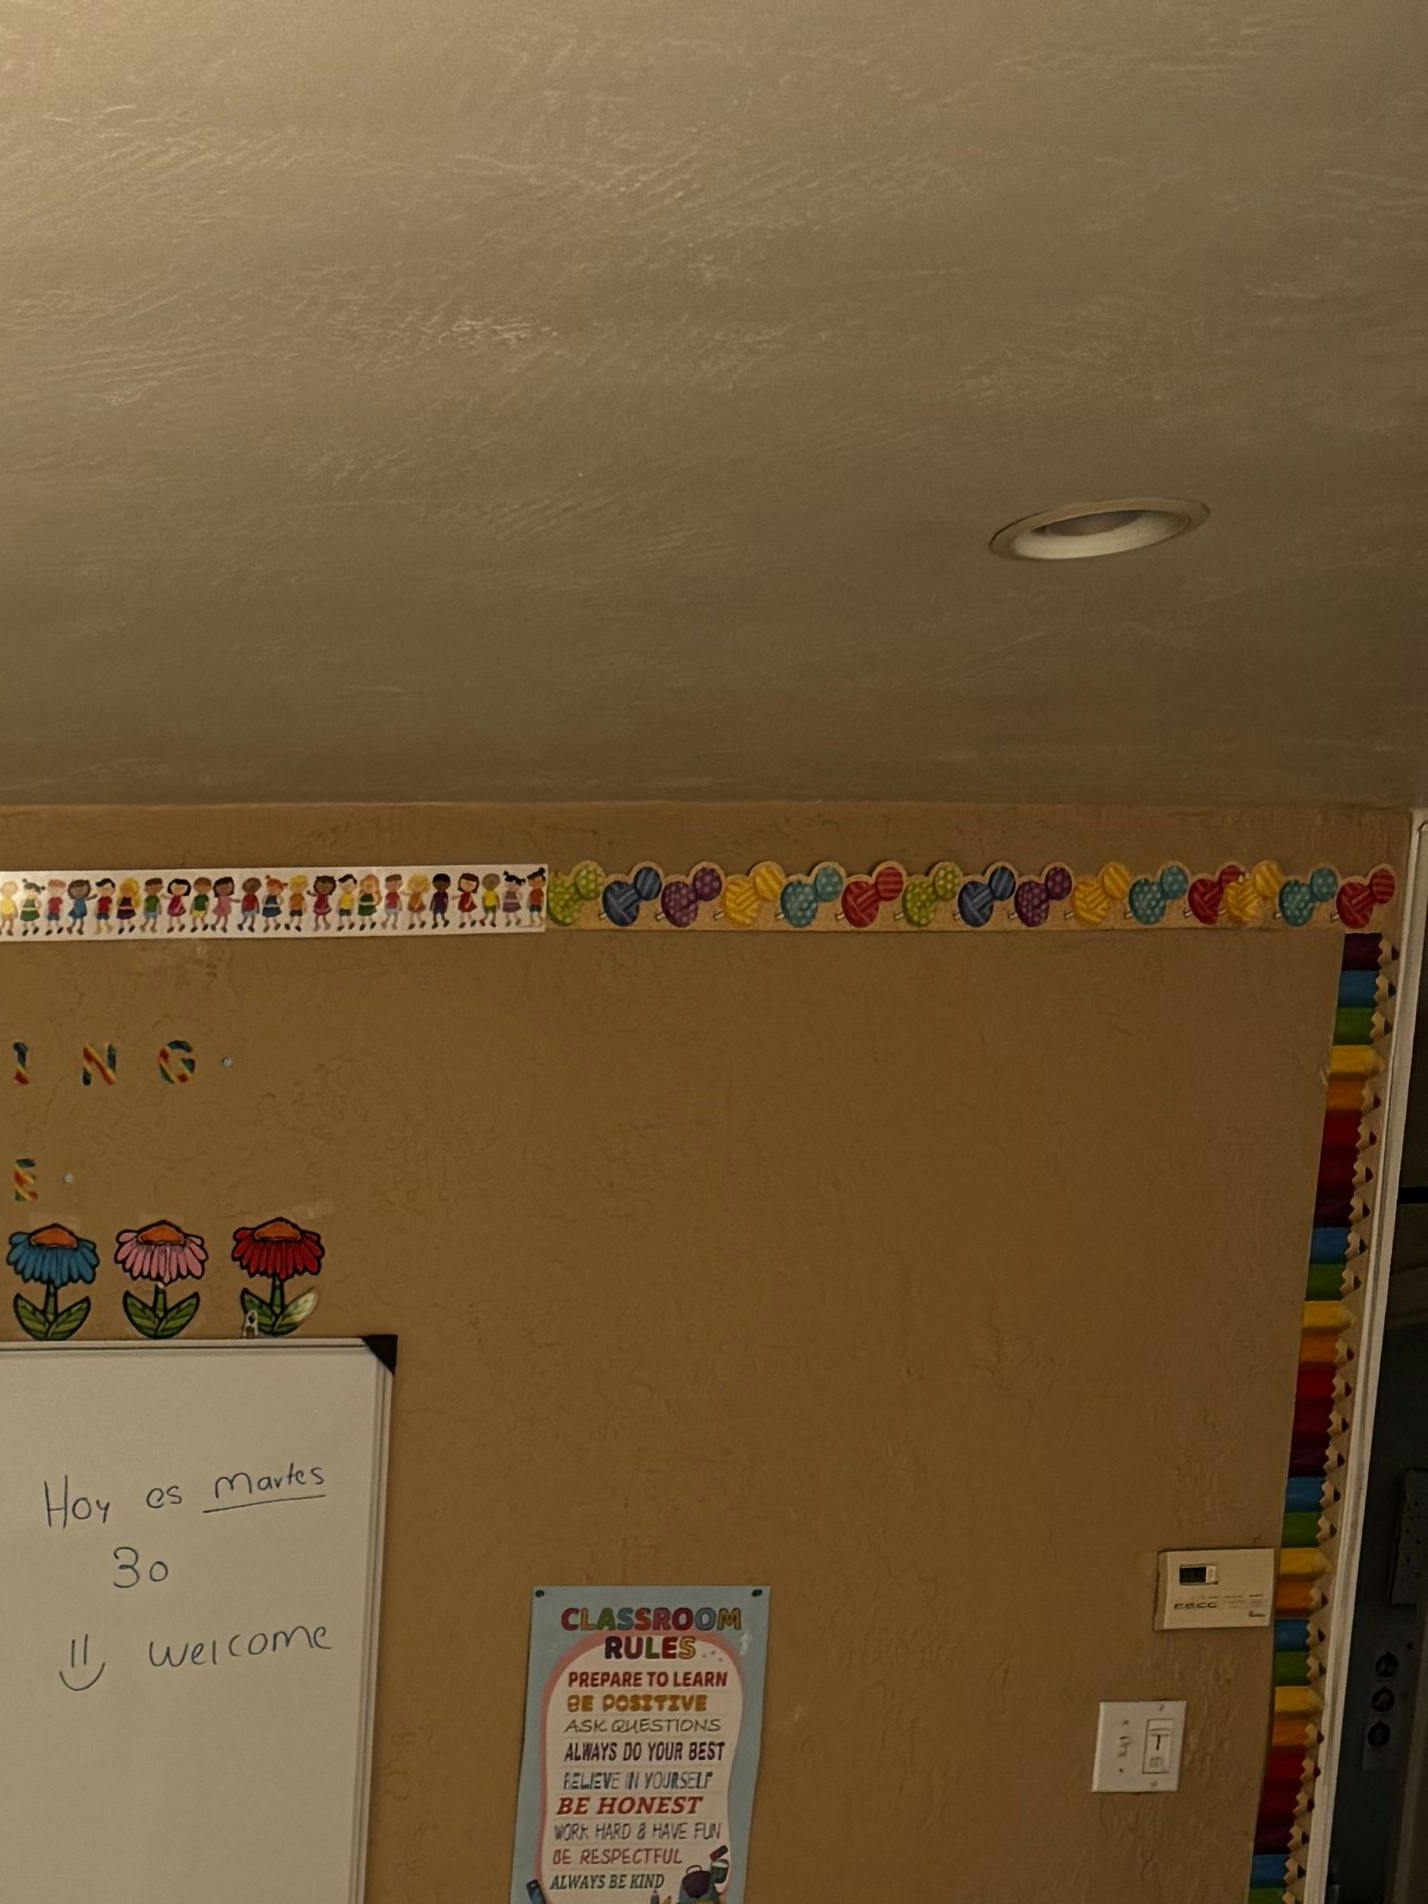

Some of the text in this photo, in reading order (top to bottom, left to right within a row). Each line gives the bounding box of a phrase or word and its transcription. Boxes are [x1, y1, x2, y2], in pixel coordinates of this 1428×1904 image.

[44, 1475, 110, 1528] Hoy
[146, 1486, 183, 1509] es
[113, 1547, 169, 1588] 30
[561, 1607, 742, 1631] CLASSROOM
[149, 1626, 332, 1668] welcome
[604, 1636, 696, 1660] RULES
[568, 1671, 728, 1688] PREPARE TO LEARN
[567, 1695, 708, 1712] BE POSITIVE
[564, 1718, 721, 1734] ASK QUESTIONS
[565, 1742, 725, 1762] ALWAYS DO YOUR BEST
[564, 1772, 714, 1790] BELIEVE IN YOURSELF
[557, 1797, 703, 1815] BE HONEST
[554, 1823, 589, 1840] WORK
[596, 1822, 631, 1840] HARD
[653, 1822, 687, 1840] HAVE
[694, 1822, 721, 1840] FUN
[553, 1848, 683, 1865] BE RESPECTFUL
[550, 1874, 665, 1890] ALWAYS BE KIND
